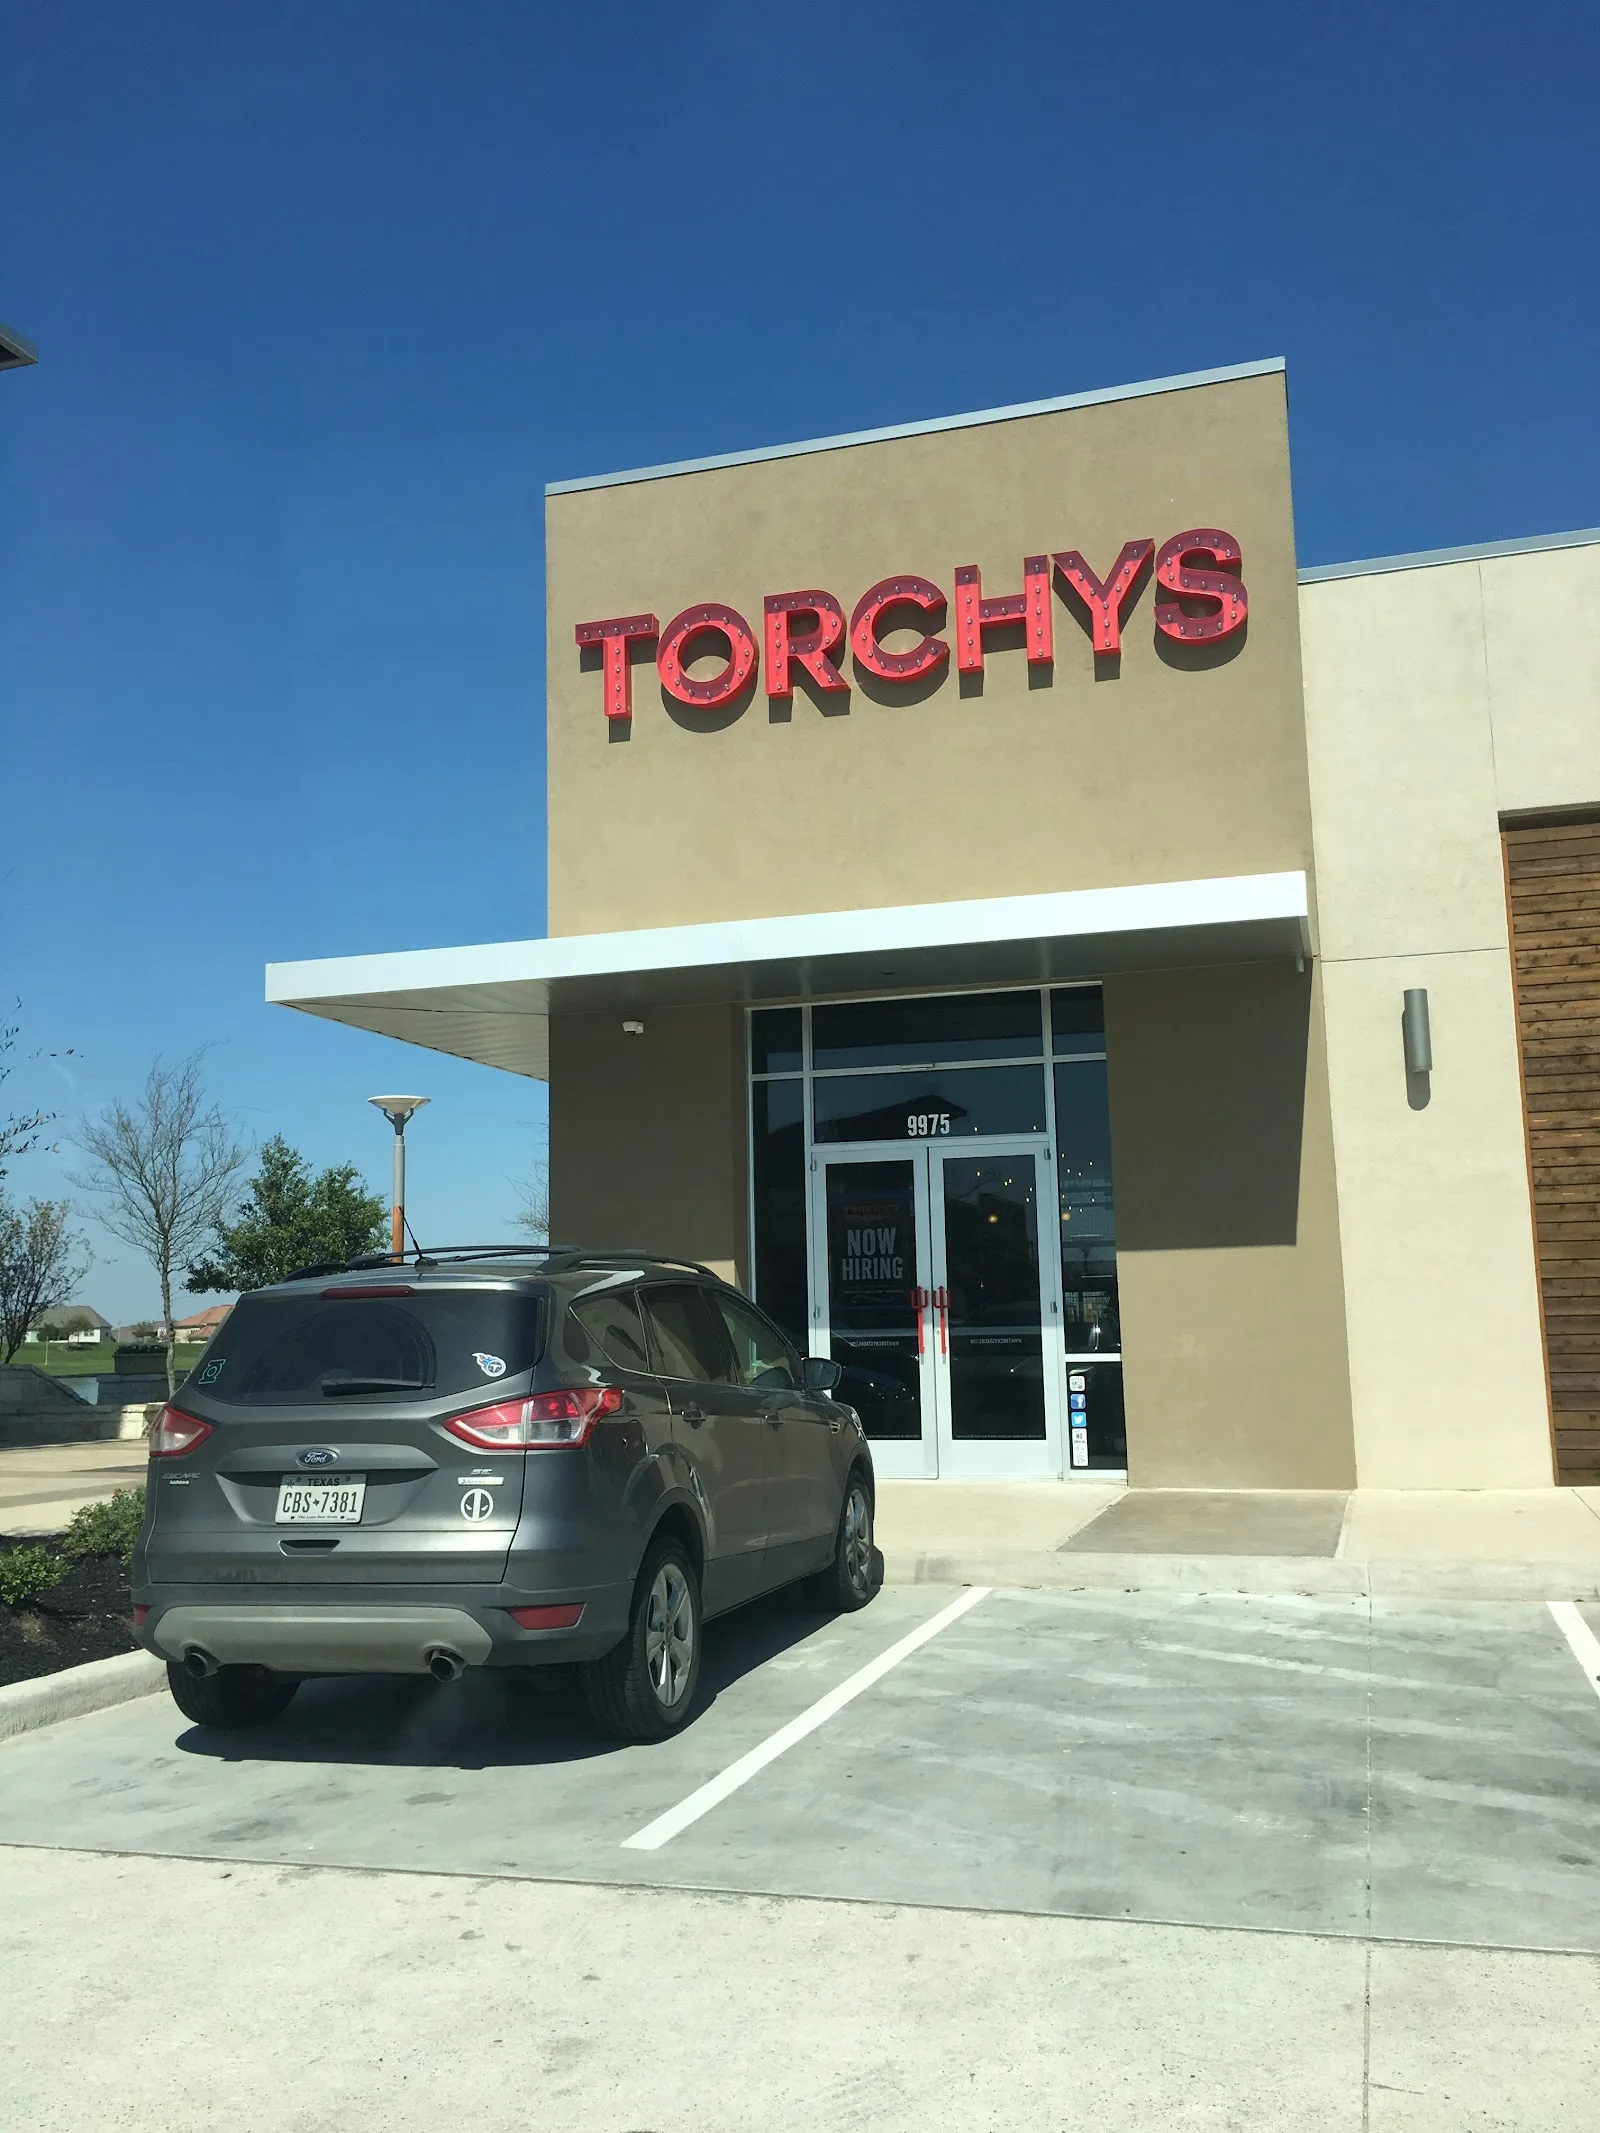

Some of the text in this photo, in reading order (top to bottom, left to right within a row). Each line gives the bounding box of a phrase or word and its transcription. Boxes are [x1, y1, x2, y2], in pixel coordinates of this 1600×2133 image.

[575, 528, 1249, 720] TORCHYS
[907, 1113, 950, 1136] 9975
[847, 1227, 896, 1256] NOW
[842, 1256, 903, 1281] HIRING
[304, 1452, 328, 1463] Ford
[307, 1478, 340, 1487] TEXAS
[282, 1491, 357, 1513] CBS 7381
